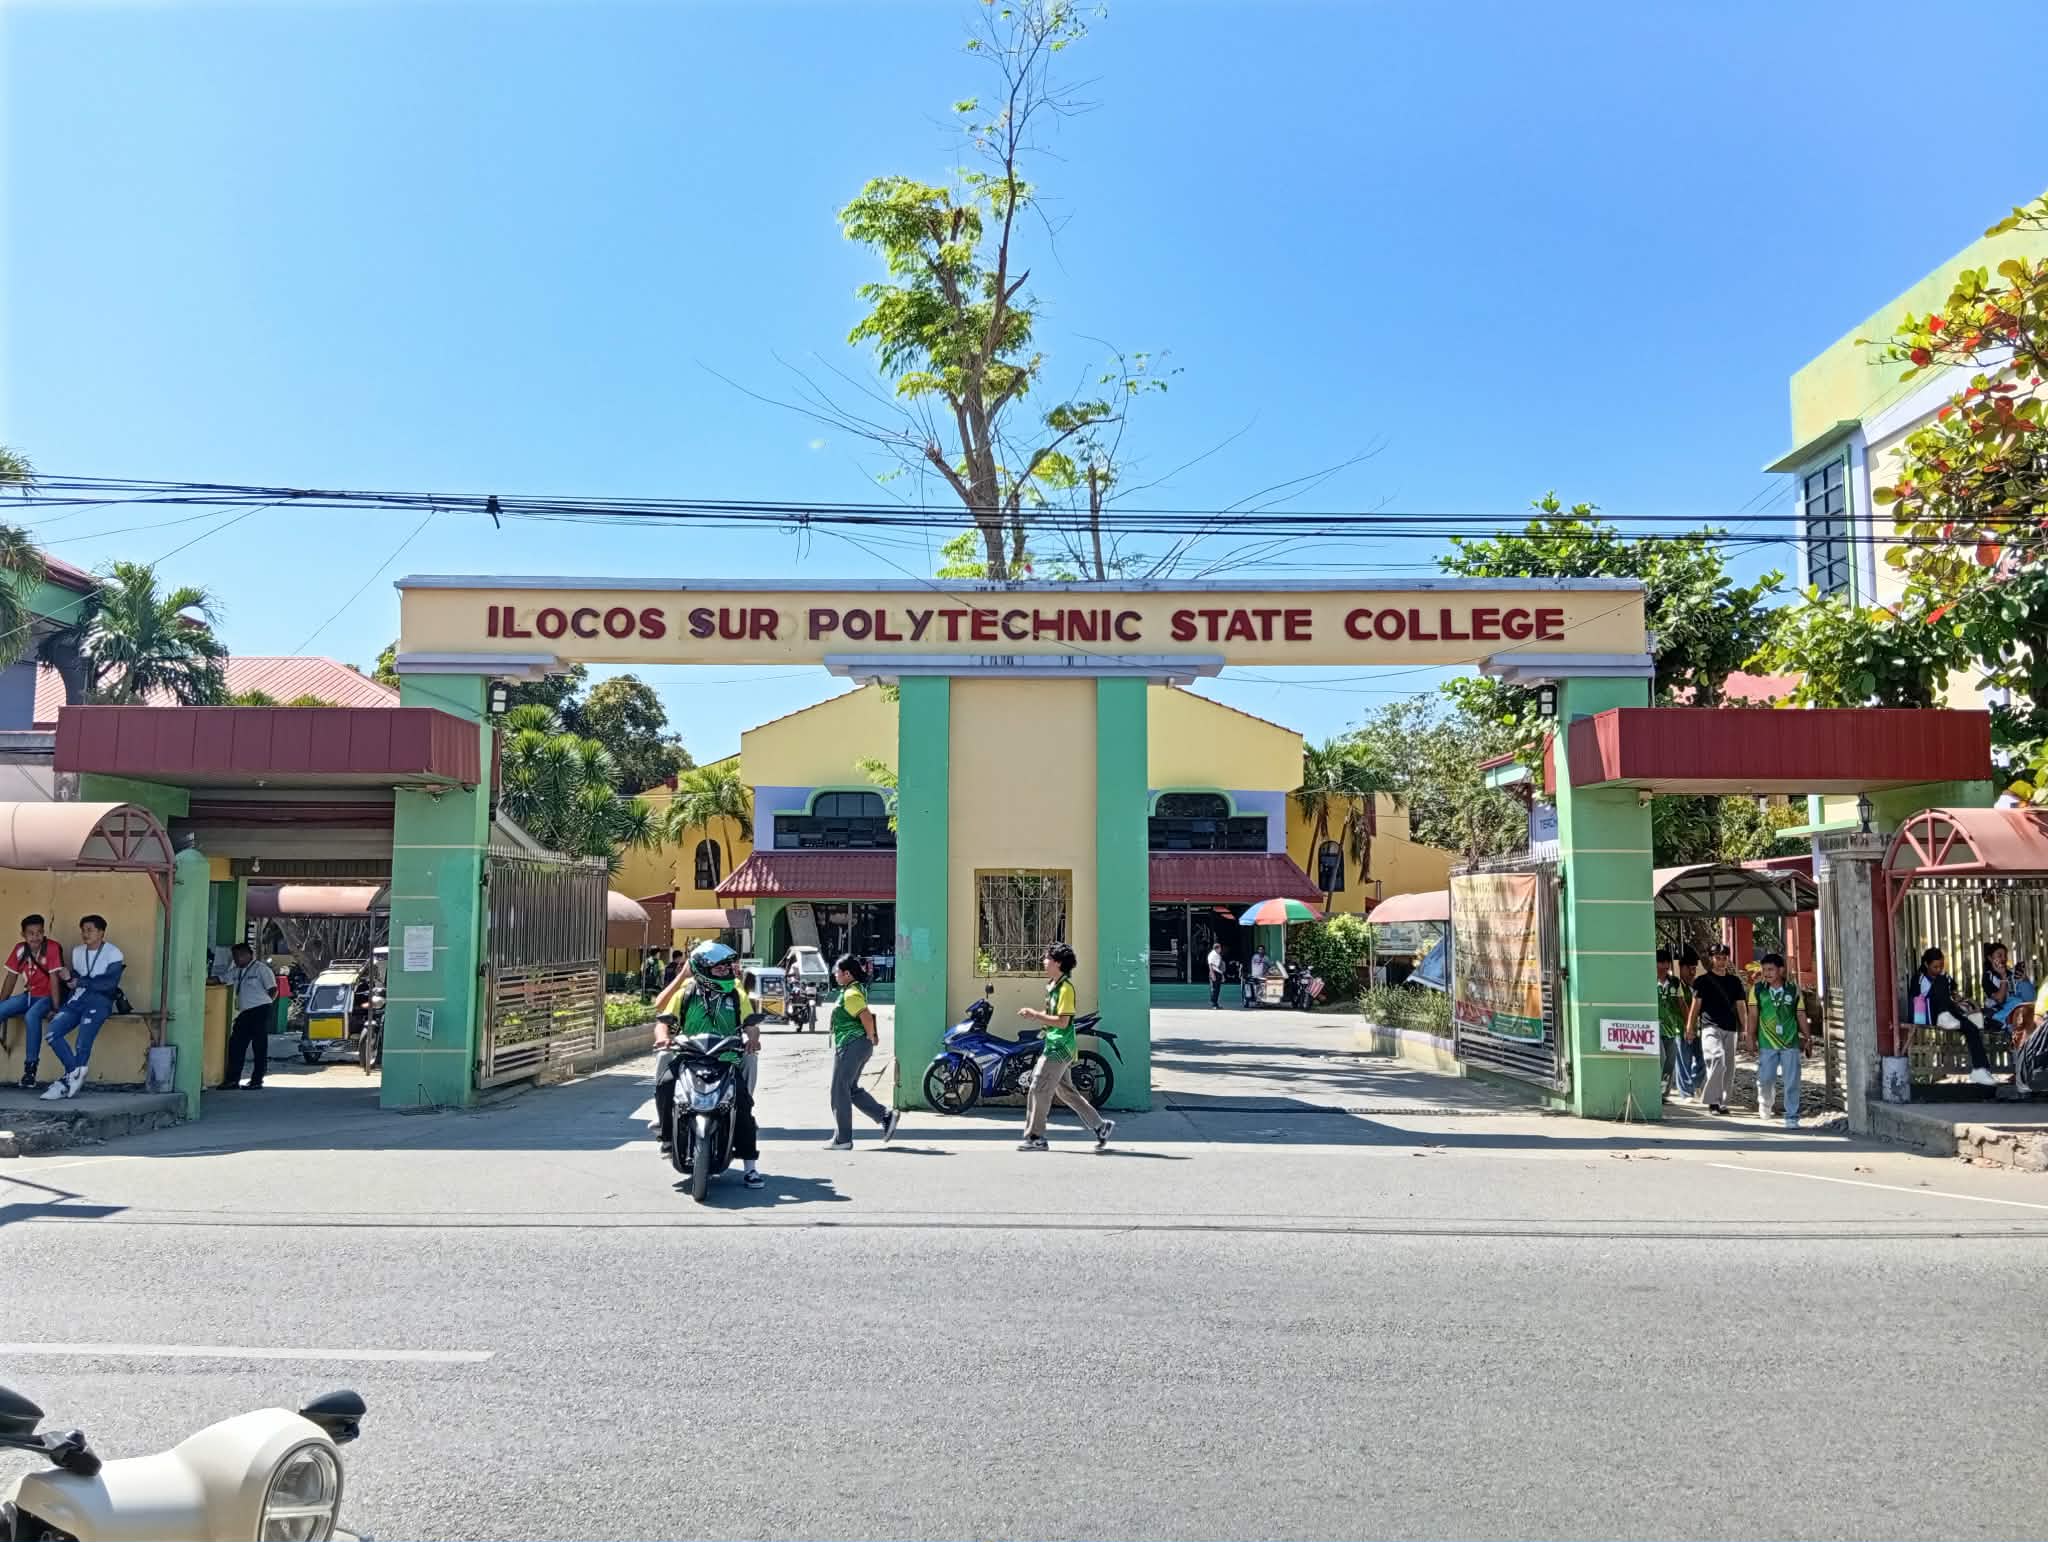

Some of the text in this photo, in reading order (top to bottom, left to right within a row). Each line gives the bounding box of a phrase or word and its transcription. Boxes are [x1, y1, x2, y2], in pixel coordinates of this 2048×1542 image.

[487, 605, 1565, 642] ILOCOS SUR POLYTECHNIC STATE COLLEGE
[1607, 1027, 1655, 1045] ENTRANCE
